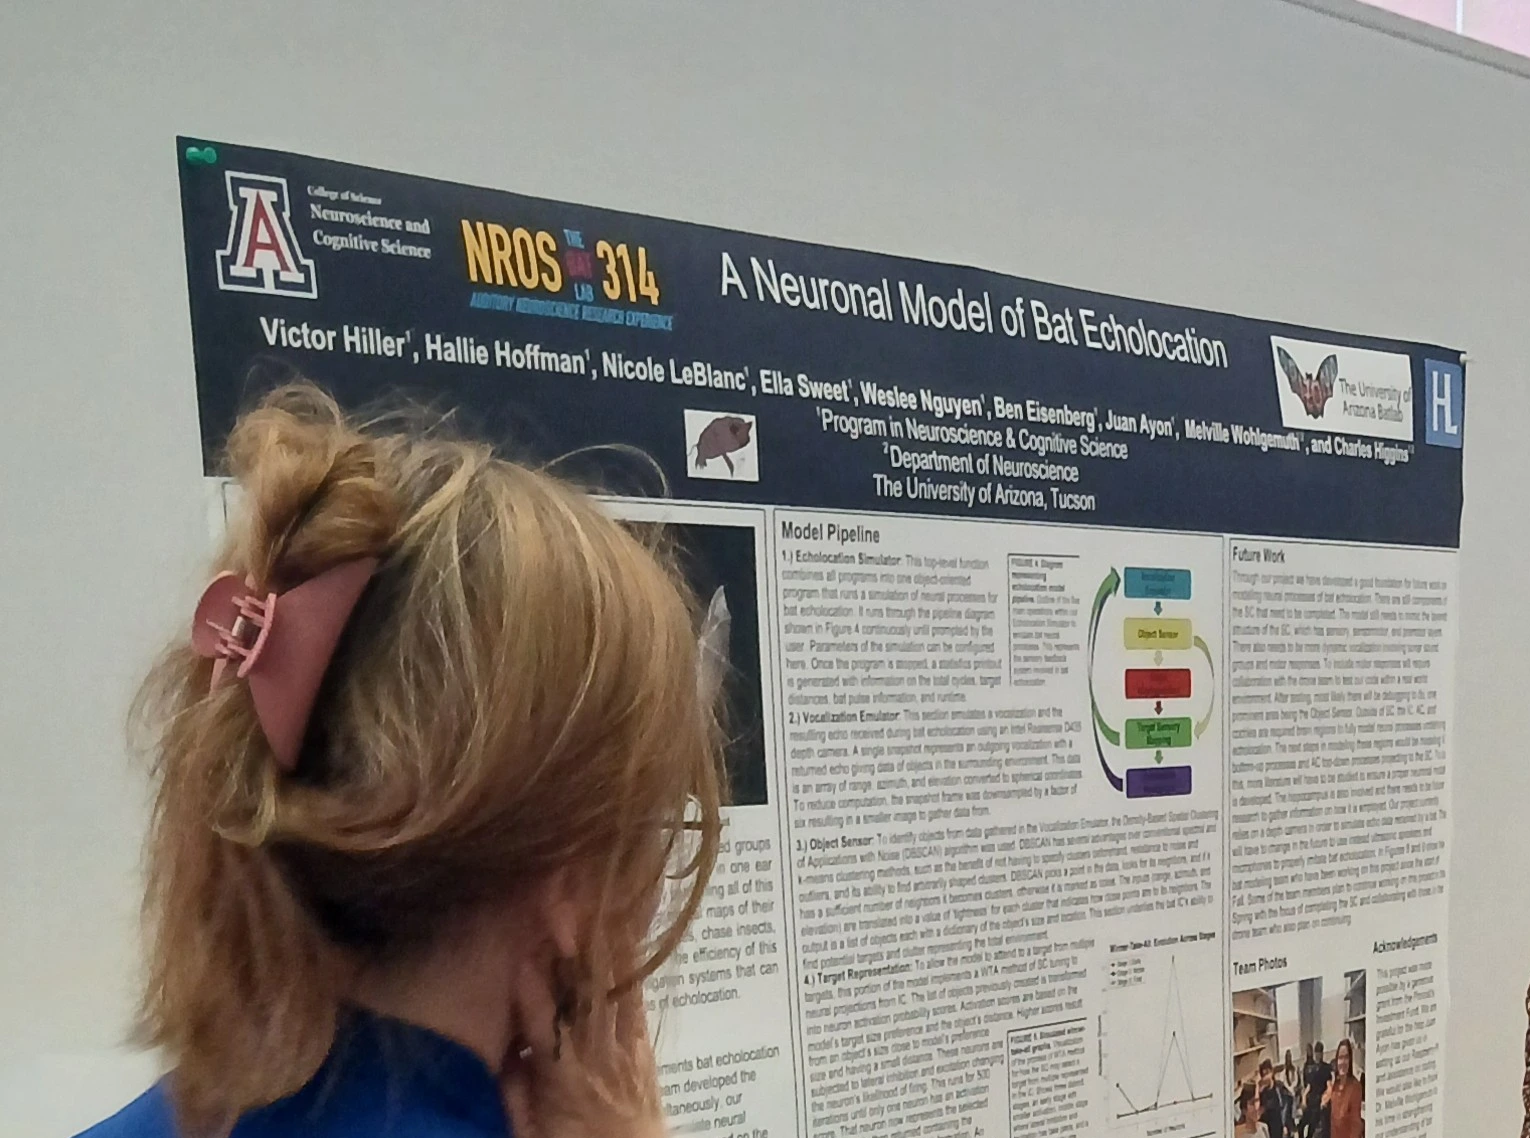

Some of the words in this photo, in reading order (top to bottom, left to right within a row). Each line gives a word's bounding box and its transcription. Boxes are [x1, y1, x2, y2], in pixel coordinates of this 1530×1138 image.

[340, 189, 350, 200] of
[310, 203, 402, 230] Neuroscience
[405, 218, 431, 235] and
[313, 229, 378, 252] Cognitive
[381, 238, 432, 259] Science
[461, 219, 562, 293] NROS
[596, 240, 659, 306] 314
[625, 309, 673, 332] EXPERIENCE
[721, 252, 748, 299] A
[750, 256, 894, 321] Neuronal
[898, 281, 993, 333] Model
[1001, 297, 1026, 338] of
[1030, 299, 1078, 346] Bat
[1079, 308, 1228, 368] Echolocation
[259, 317, 336, 351] Victor
[425, 333, 488, 366] Hallie
[602, 351, 664, 383] Nicole
[760, 369, 793, 396] Ella
[860, 380, 917, 410] Weslee
[994, 397, 1023, 420] Ben
[1106, 409, 1137, 433] Juan
[1185, 419, 1230, 445] Melville
[1311, 436, 1332, 454] and
[1334, 436, 1372, 459] Charles
[1339, 378, 1357, 397] The
[1358, 383, 1402, 408] University
[1402, 386, 1412, 403] of
[889, 416, 903, 438] in
[905, 418, 1002, 448] Neuroscience
[1005, 427, 1016, 448] &
[1018, 428, 1077, 457] Cognitive
[1080, 435, 1129, 460] Science
[976, 454, 990, 475] of
[993, 455, 1080, 482] Neuroscience
[873, 473, 903, 498] The
[906, 477, 976, 508] University
[978, 483, 992, 505] of
[995, 484, 1048, 512] Arizona,
[1050, 487, 1096, 512] Tucson
[781, 521, 823, 540] Model
[827, 523, 880, 545] Pipeline
[795, 550, 856, 565] Echolocation
[1233, 546, 1261, 563] Future
[1263, 548, 1286, 563] Work
[803, 711, 858, 724] Vocalization
[734, 838, 771, 856] groups
[809, 837, 839, 853] Object
[730, 862, 750, 874] one
[755, 859, 772, 872] ear
[727, 880, 739, 896] all
[742, 879, 752, 894] of
[755, 878, 774, 892] this
[706, 906, 735, 920] maps
[738, 901, 748, 915] of
[752, 899, 774, 913] their
[701, 925, 733, 940] chase
[736, 920, 776, 937] insects,
[692, 946, 742, 963] efficiency
[745, 942, 756, 956] of
[759, 941, 777, 955] this
[688, 968, 732, 988] systems
[736, 963, 756, 978] that
[759, 962, 778, 976] can
[817, 968, 846, 985] Target
[1233, 961, 1256, 976] Team
[1258, 956, 1288, 973] Photos
[696, 1055, 713, 1070] bat
[715, 1044, 780, 1066] echolocation
[684, 1071, 738, 1094] developed
[740, 1069, 757, 1083] the
[725, 1092, 743, 1106] our
[714, 1111, 746, 1129] neural
